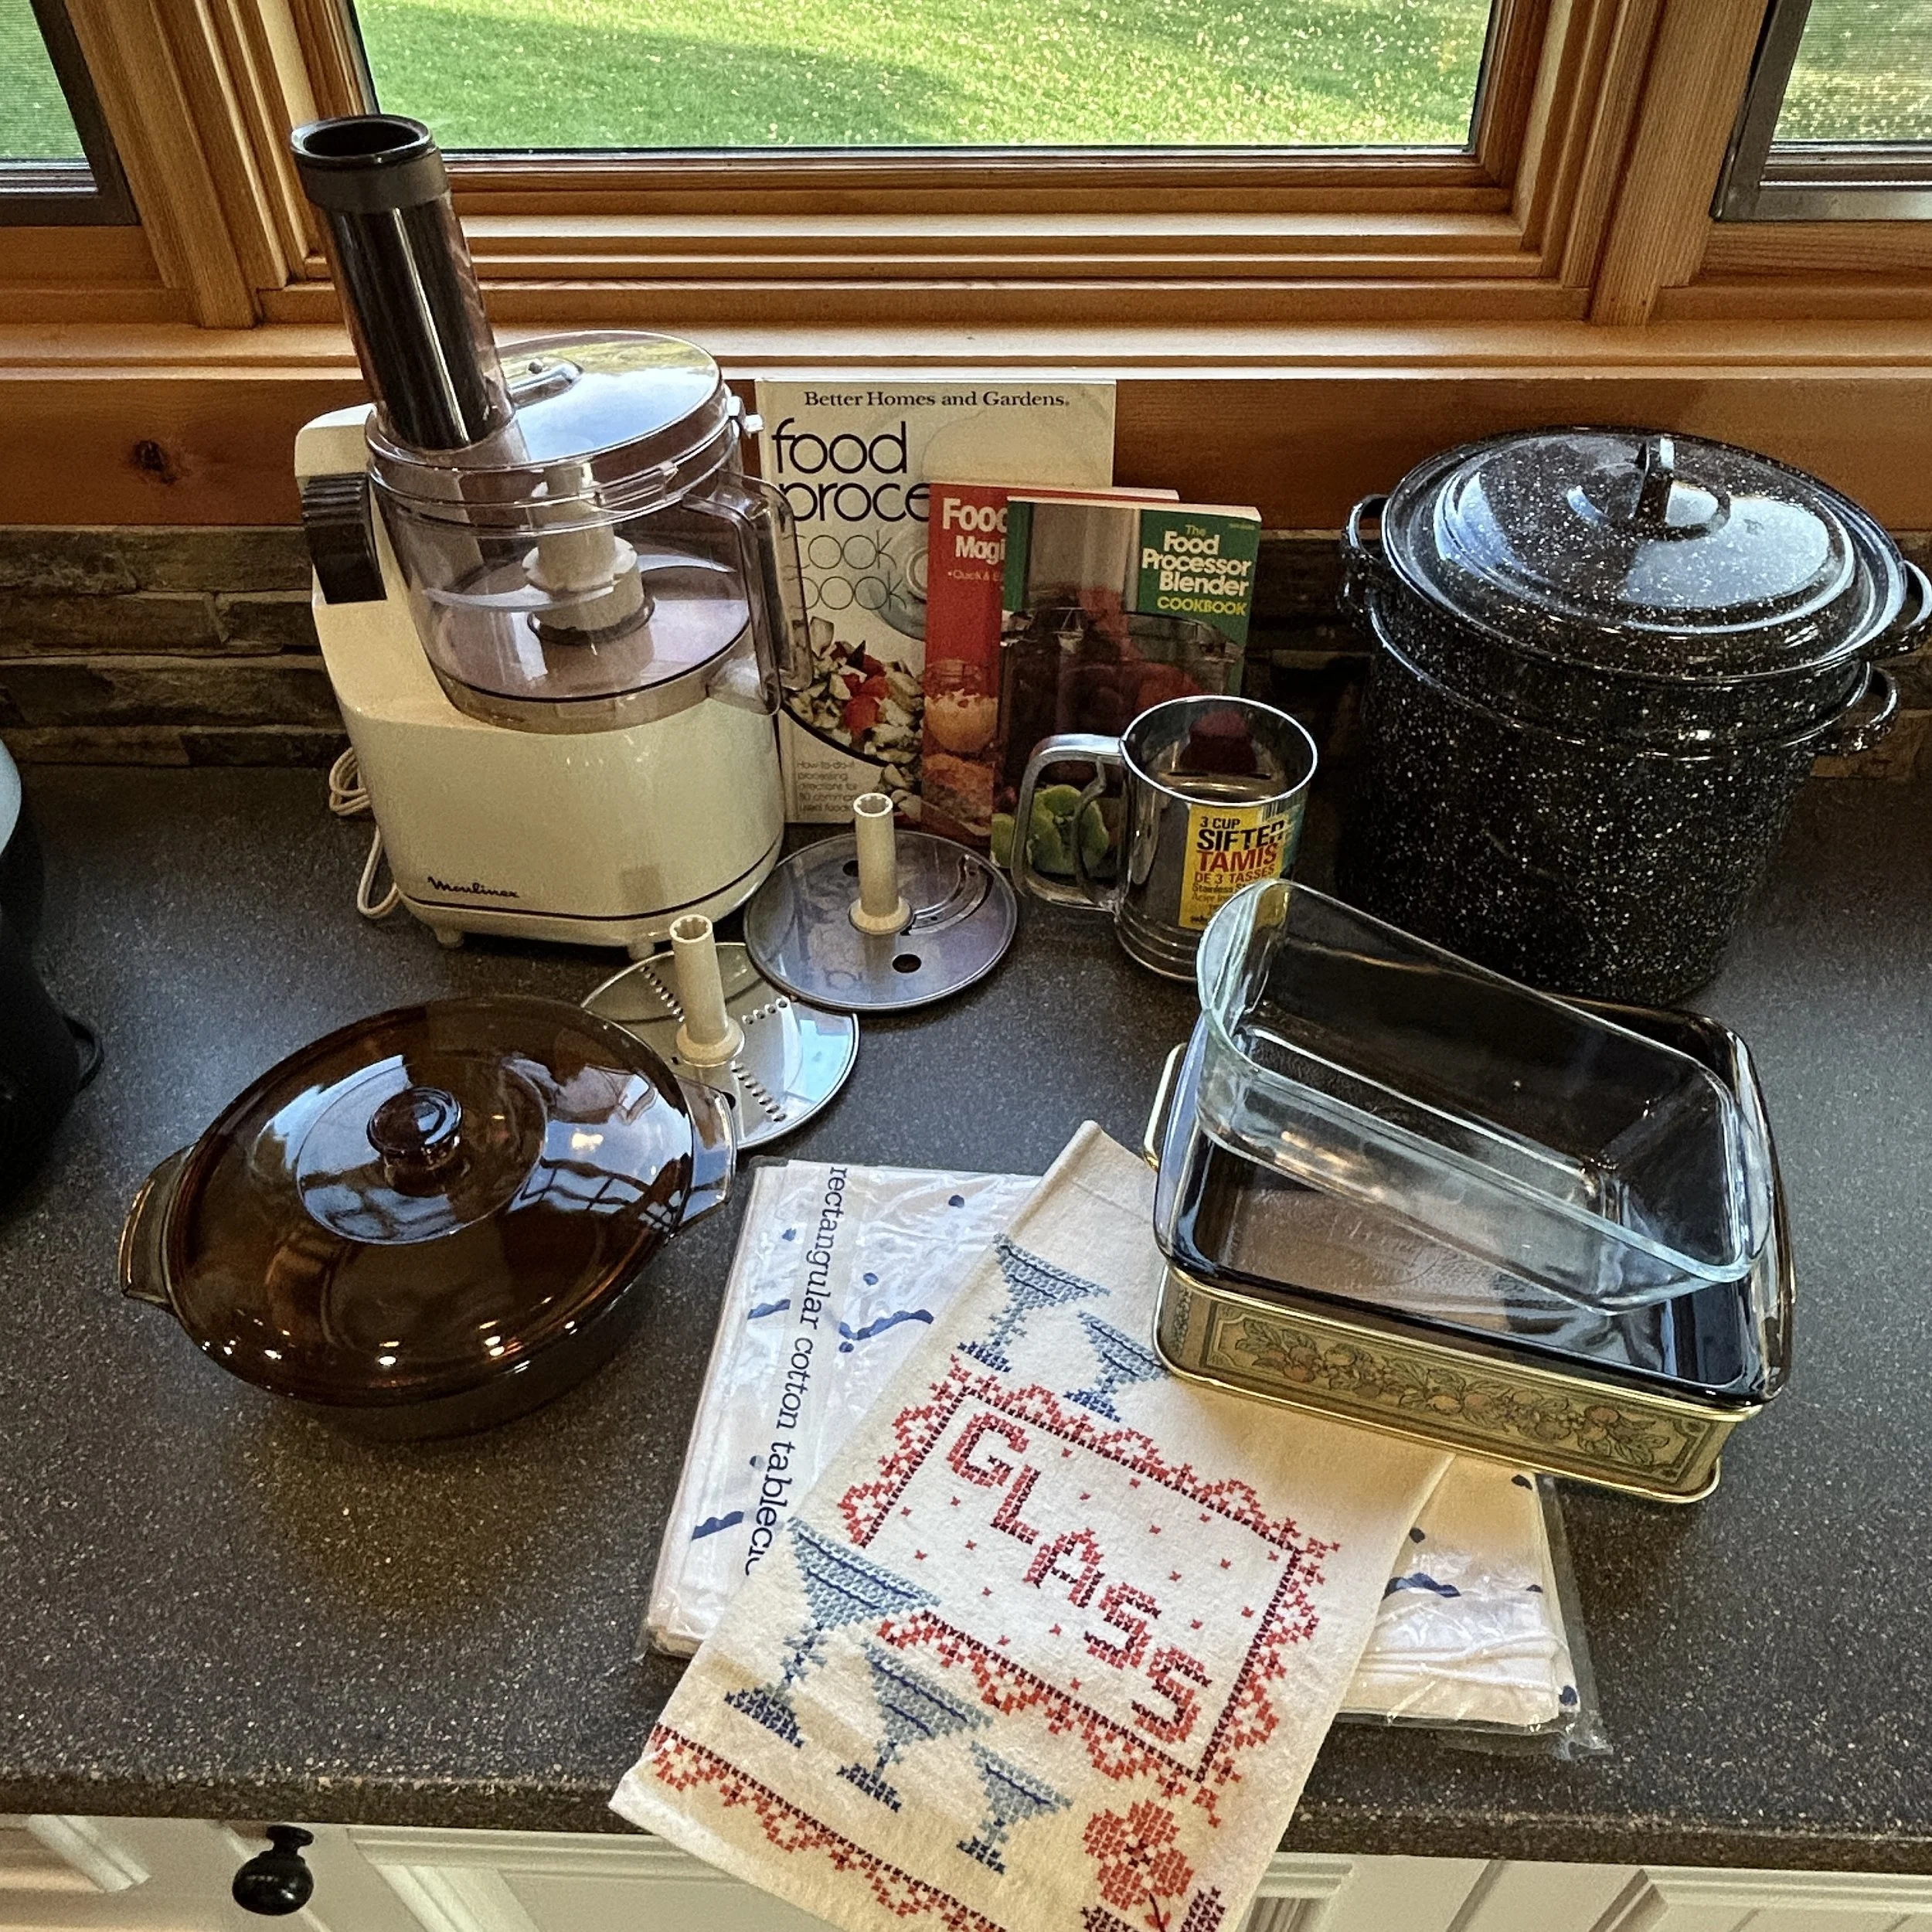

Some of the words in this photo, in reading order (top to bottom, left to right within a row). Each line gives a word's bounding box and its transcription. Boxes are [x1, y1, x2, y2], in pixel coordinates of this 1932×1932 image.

[804, 391, 863, 406] Better
[867, 391, 935, 406] Homes
[941, 391, 978, 406] and
[772, 417, 907, 474] food
[1164, 530, 1220, 556] Food
[1185, 524, 1206, 536] The
[1141, 548, 1252, 577] Processor
[1159, 570, 1250, 597] Blender
[1157, 596, 1247, 616] COOKBOOK
[1196, 820, 1284, 851] SIFTER
[1200, 817, 1208, 828] 3
[1213, 818, 1240, 829] CUP
[1198, 842, 1277, 872] TAMIS
[427, 876, 520, 898] Moulinex
[1195, 872, 1211, 883] DE
[1214, 873, 1223, 884] 3
[1229, 864, 1275, 883] TASSES
[799, 1166, 849, 1331] rectangular
[776, 1336, 815, 1430] cotton
[946, 1411, 1213, 1743] GLASS
